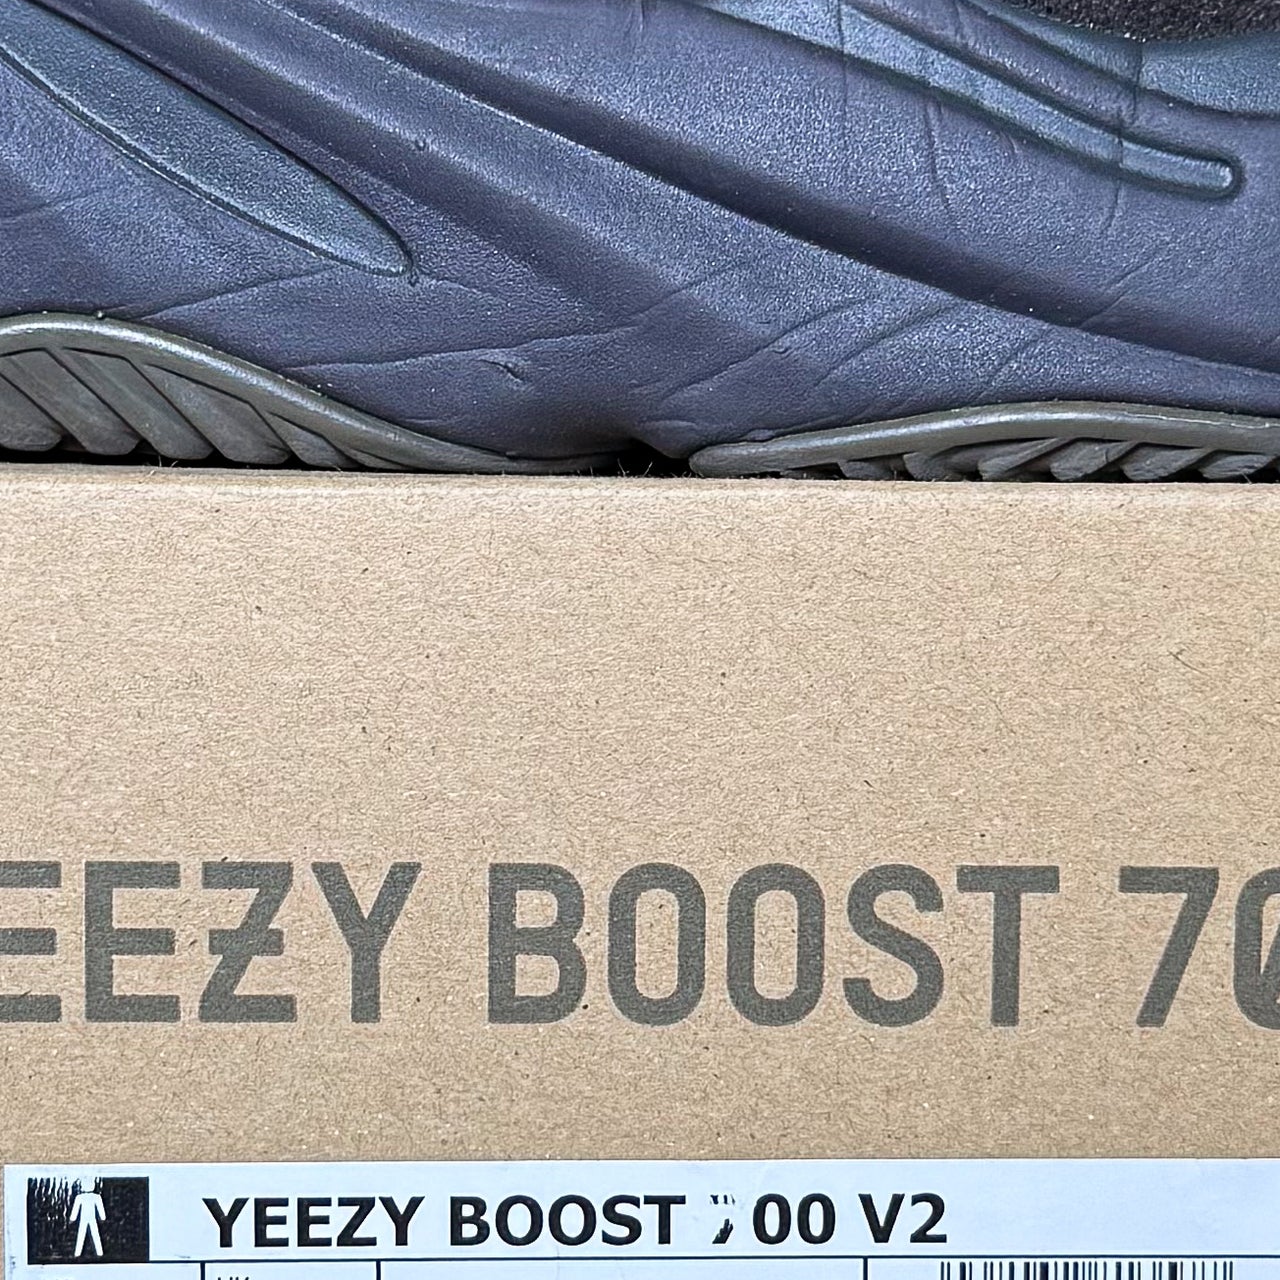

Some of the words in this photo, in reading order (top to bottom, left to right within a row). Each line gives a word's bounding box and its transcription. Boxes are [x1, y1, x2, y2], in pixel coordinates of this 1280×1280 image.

[487, 862, 1061, 1028] BOOST
[201, 1195, 426, 1249] YEEZY
[449, 1194, 687, 1247] BOOST
[857, 1192, 948, 1244] V2
